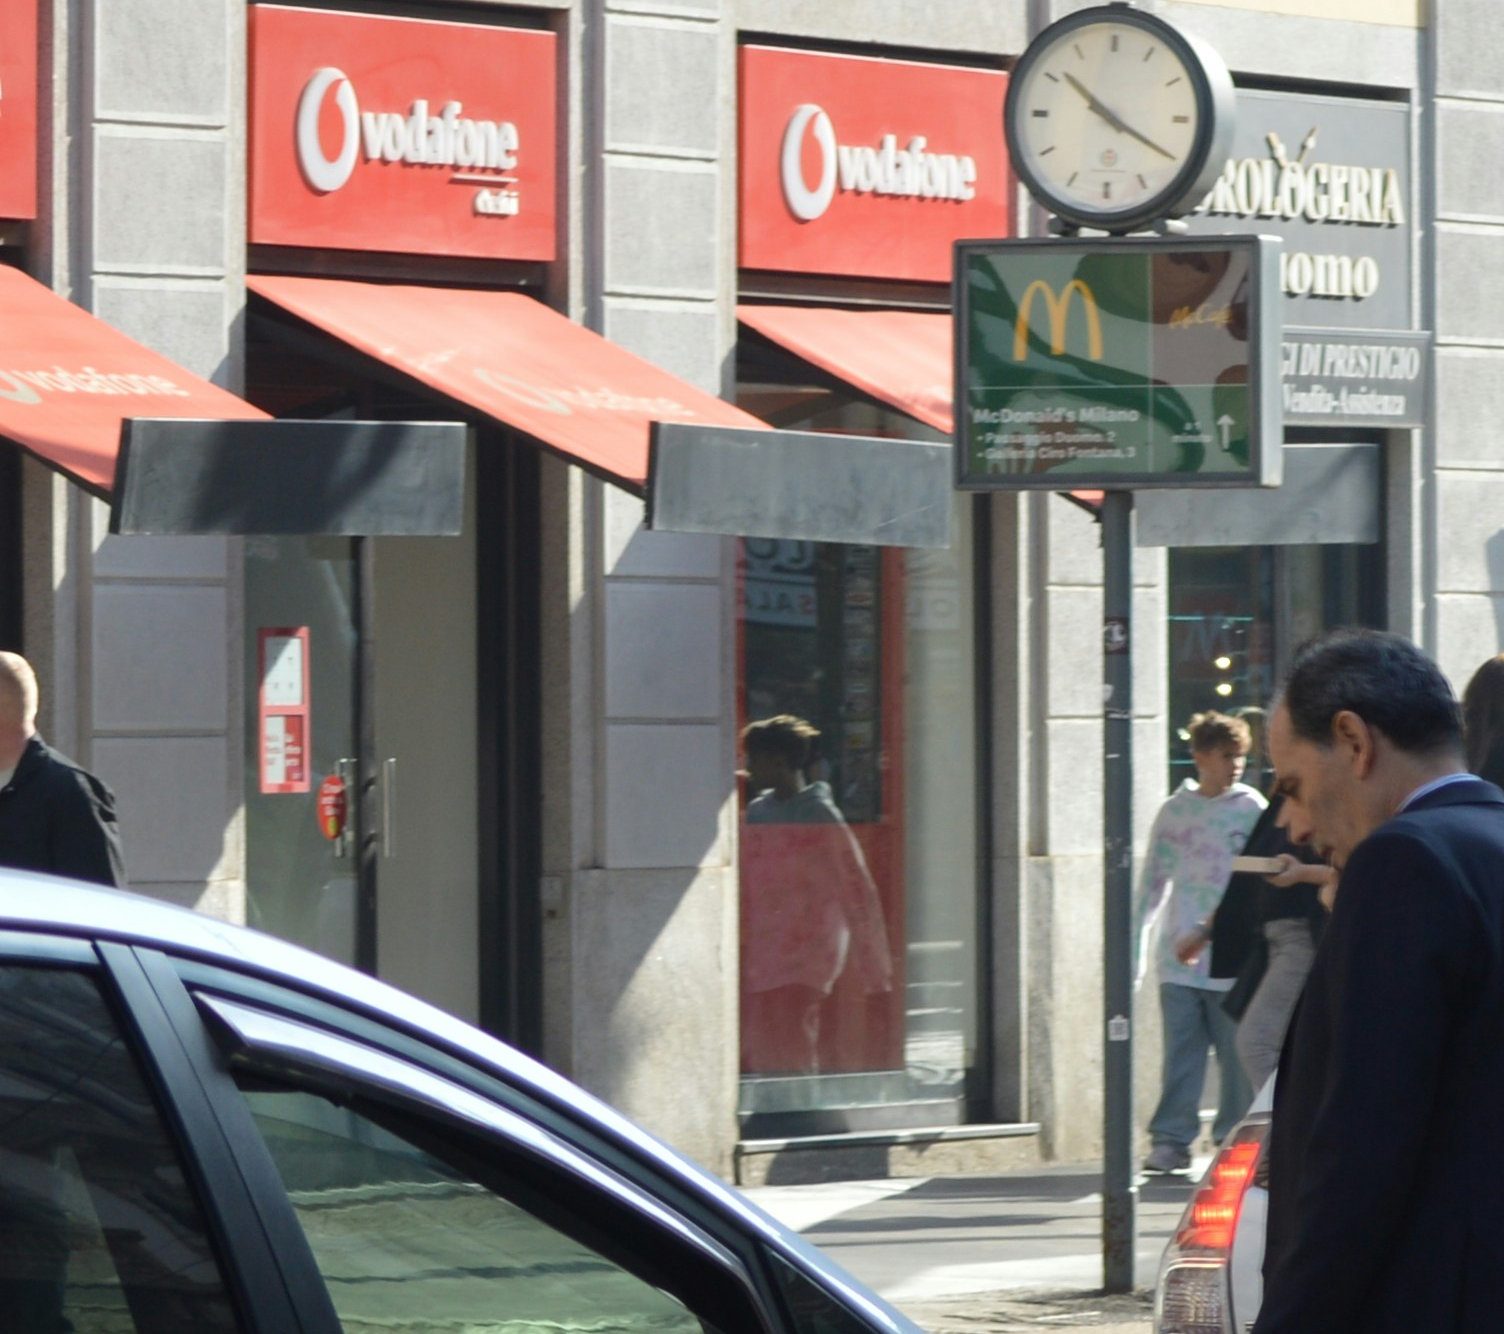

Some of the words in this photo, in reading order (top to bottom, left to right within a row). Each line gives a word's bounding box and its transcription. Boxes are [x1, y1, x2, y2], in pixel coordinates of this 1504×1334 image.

[360, 99, 520, 170] vodafone
[836, 134, 978, 201] vodafone
[1194, 157, 1405, 225] ROLOGERIA
[1280, 252, 1380, 299] omo
[1323, 345, 1420, 380] PRESTIGIO
[1079, 407, 1139, 422] Milano
